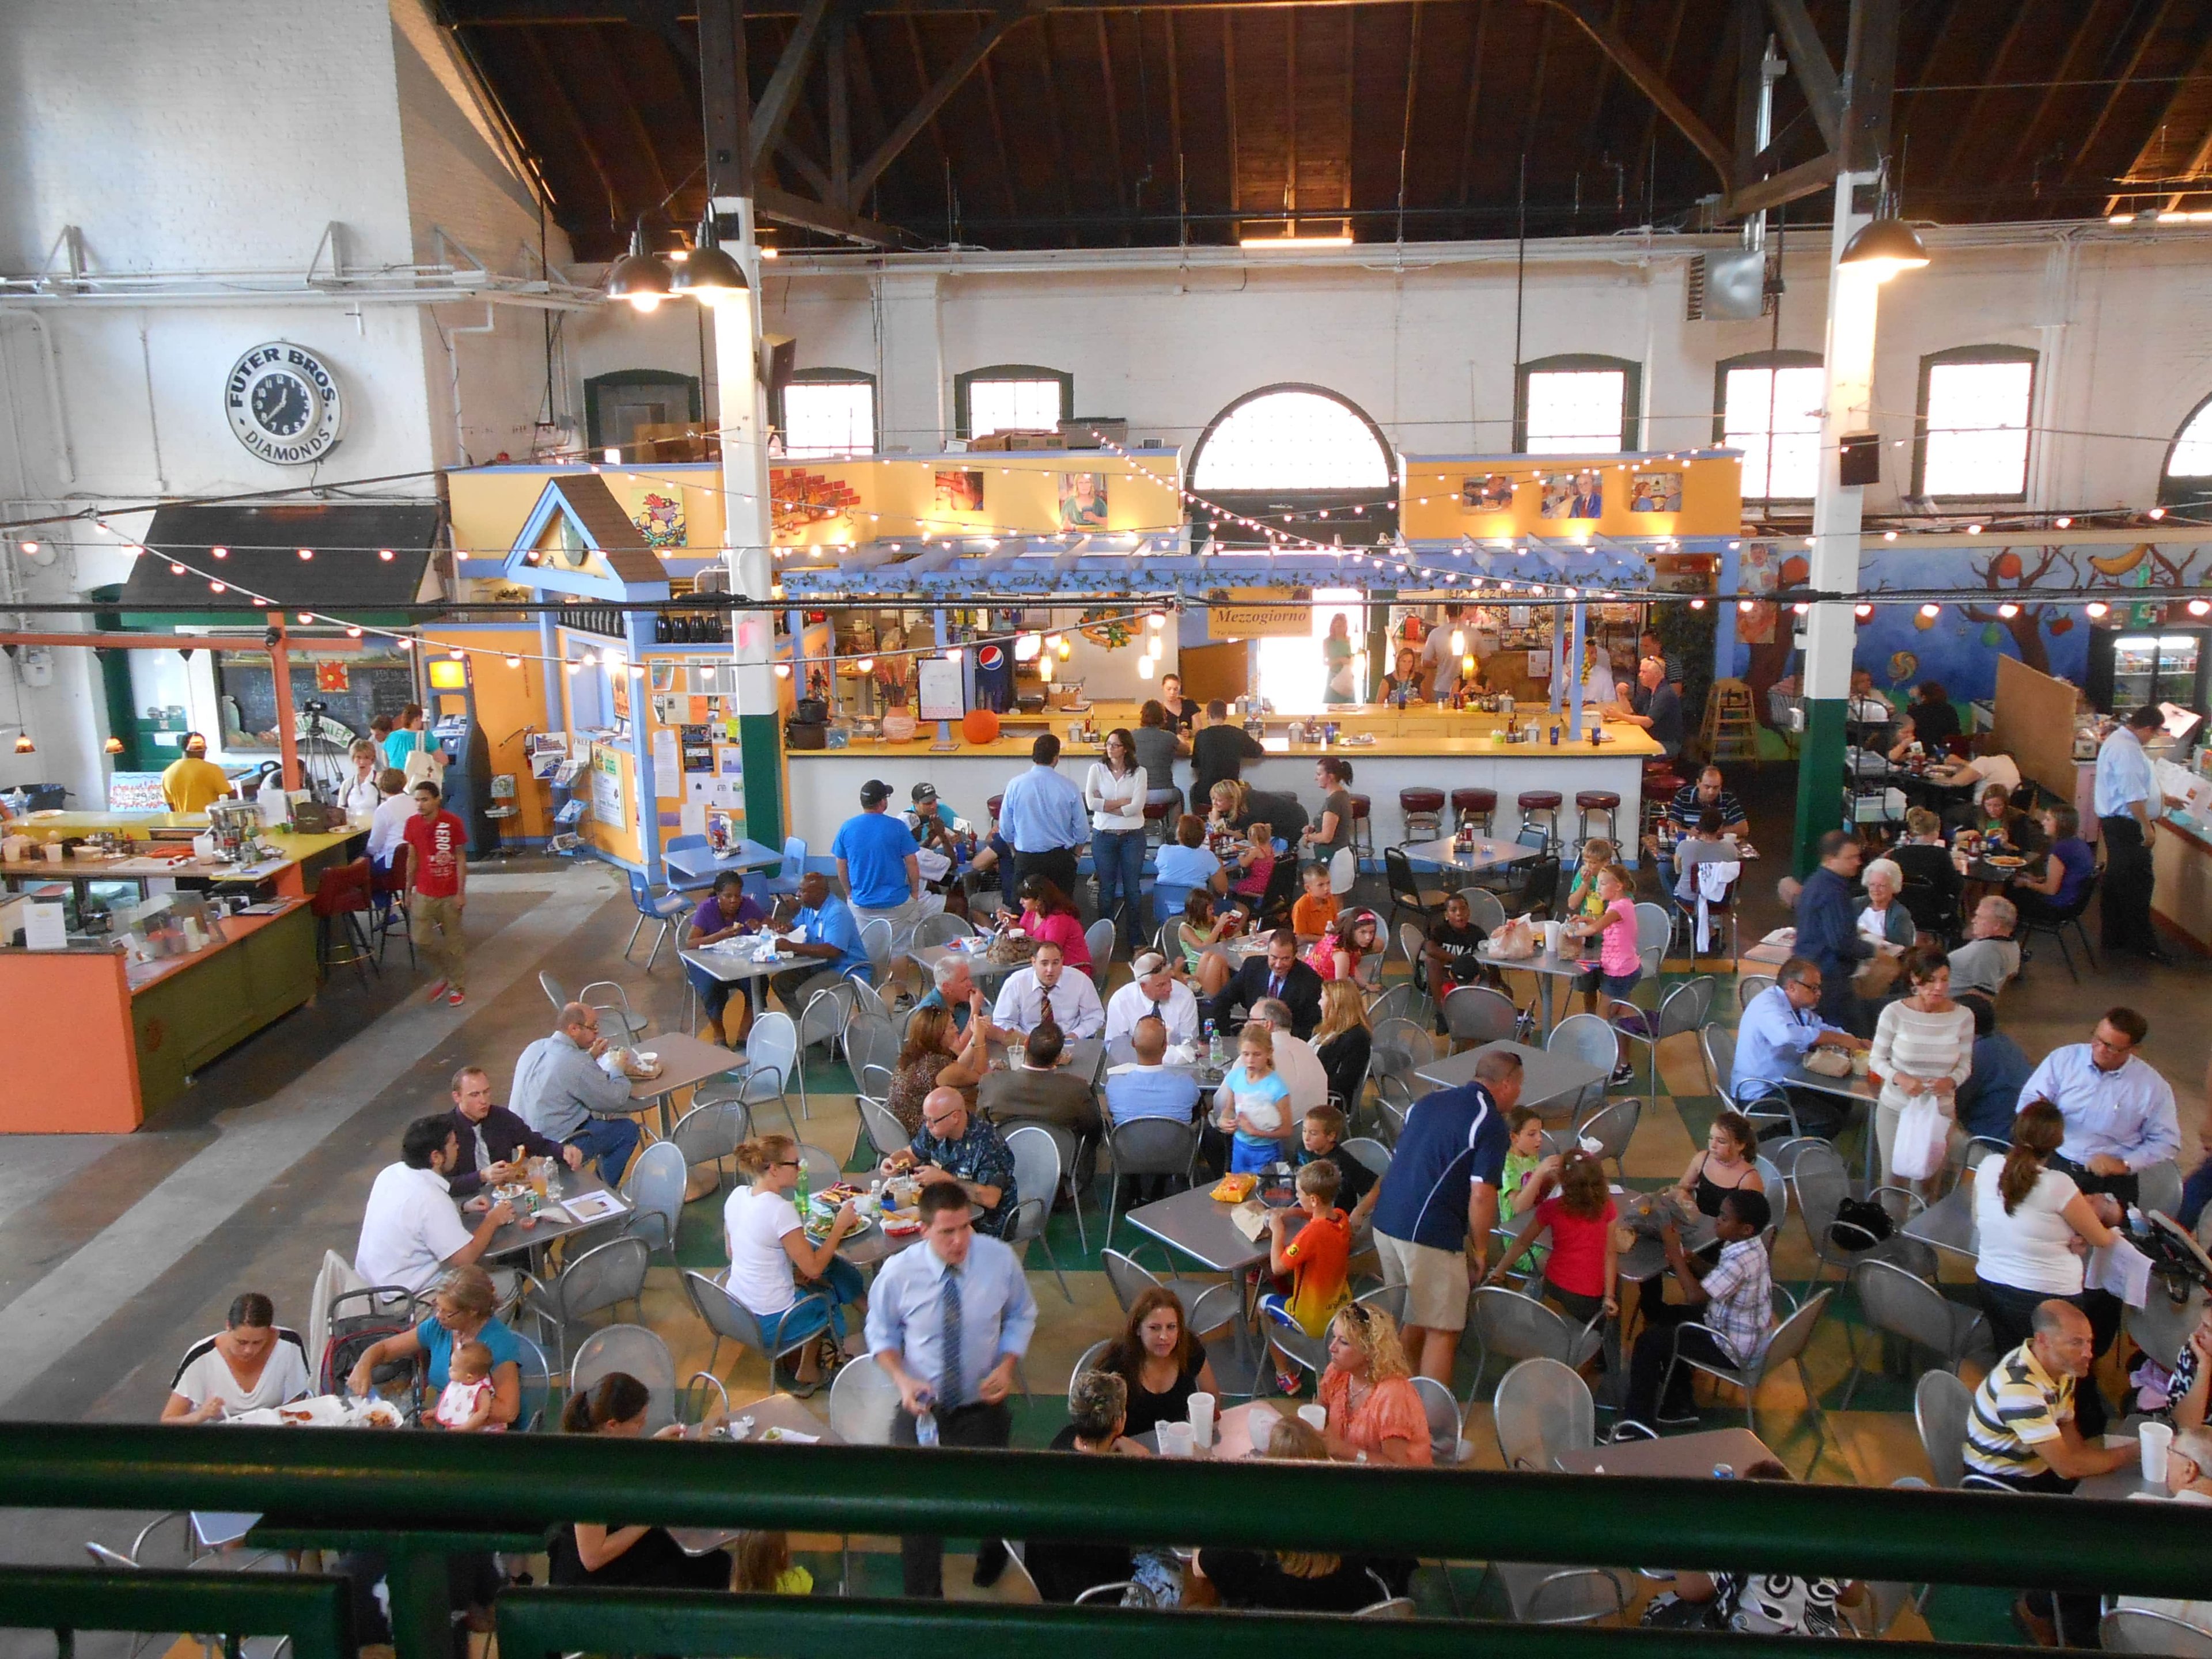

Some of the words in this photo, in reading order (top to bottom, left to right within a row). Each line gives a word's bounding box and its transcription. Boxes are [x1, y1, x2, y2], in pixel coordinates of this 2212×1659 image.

[230, 348, 281, 407] FUTER
[288, 349, 335, 407] BROS.
[244, 428, 330, 461] DIAMONDS
[1215, 609, 1306, 624] Mezzogiorno
[573, 738, 589, 746] FREE
[435, 822, 451, 850] AERO
